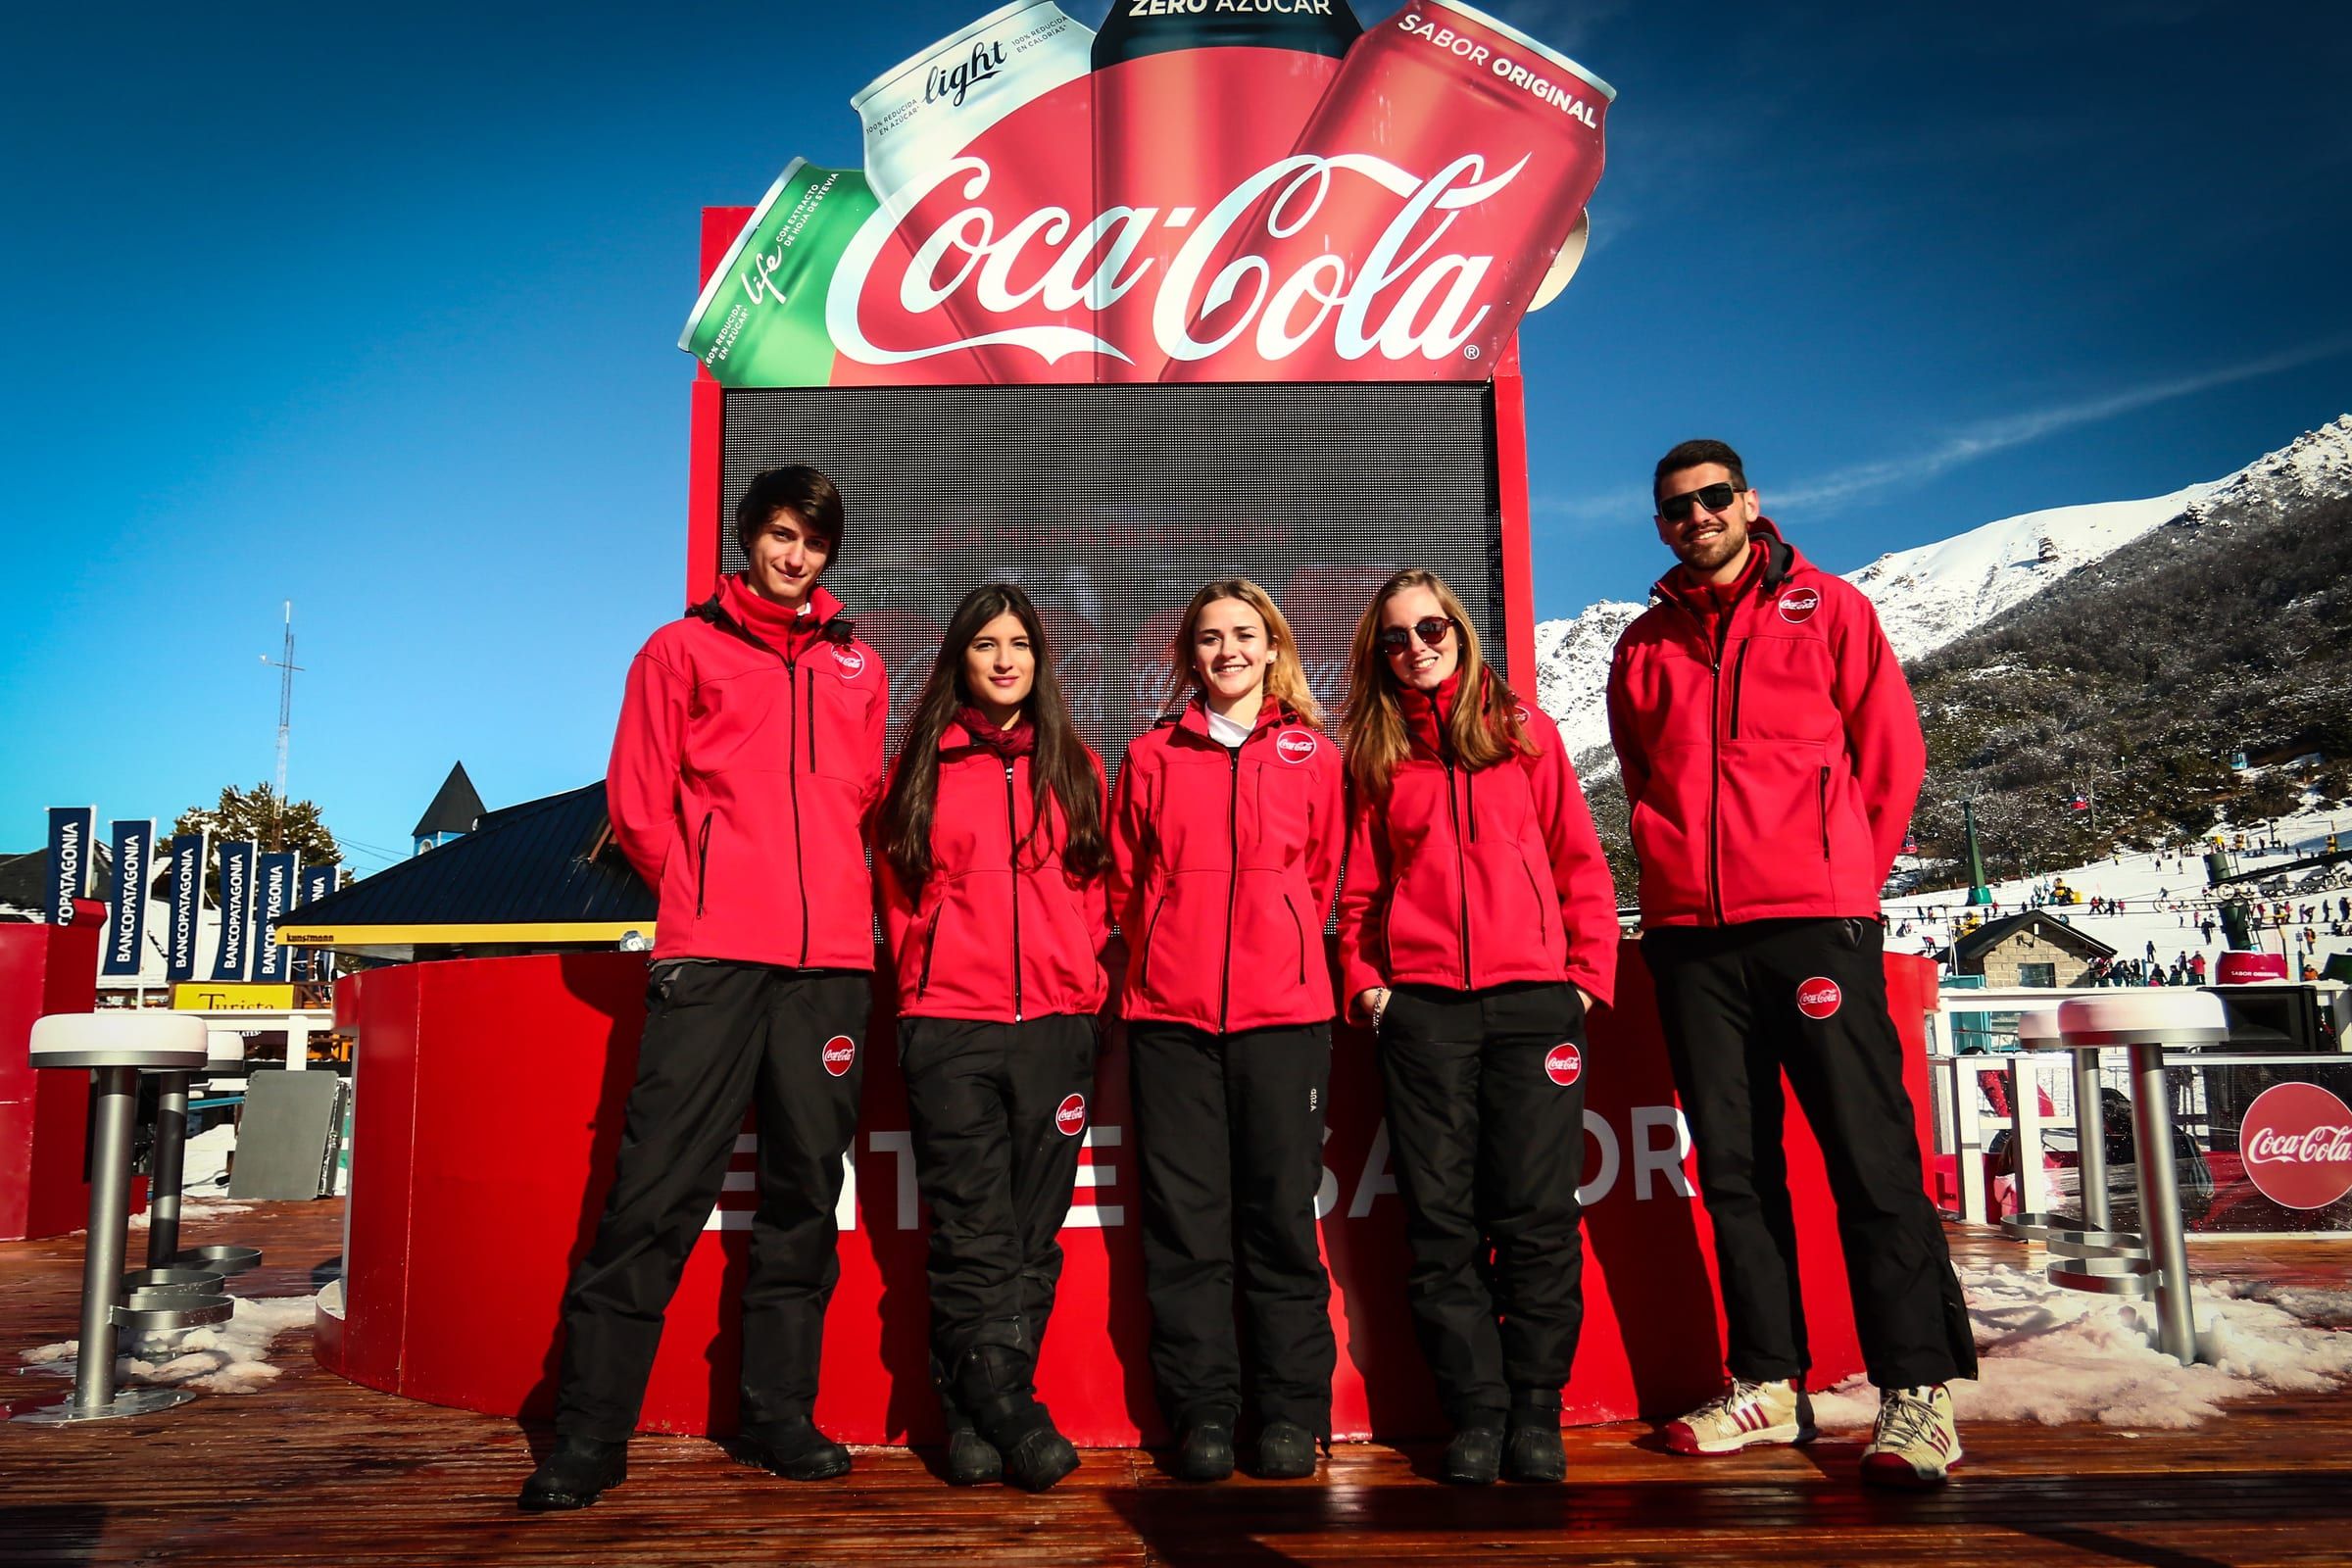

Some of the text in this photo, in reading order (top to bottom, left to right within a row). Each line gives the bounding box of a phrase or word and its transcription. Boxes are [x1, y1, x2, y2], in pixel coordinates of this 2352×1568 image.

[1011, 16, 1068, 47] 100% REDUCIDA
[1128, 0, 1206, 18] ZERO
[921, 40, 1007, 108] light
[1016, 43, 1028, 53] EN
[1397, 14, 1597, 129] SABOR ORIGINAL
[866, 98, 918, 135] 100% REDUCIDA
[878, 124, 890, 136] EN
[775, 183, 819, 243] CON EXTRACTO
[783, 172, 840, 248] DE HOJA DE STEVIA
[740, 245, 788, 306] life
[825, 153, 1532, 366] Coca-Cola
[714, 303, 743, 346] REDUCIDA
[718, 347, 730, 361] EN
[116, 834, 139, 963] BANCOPATAGONIA
[174, 847, 194, 969] BANCOPATAGONIA
[223, 853, 243, 969] BANCOPATAGONIA
[262, 864, 283, 975] BANCOPTAGONIA
[2247, 1124, 2352, 1164] Coca-Cola
